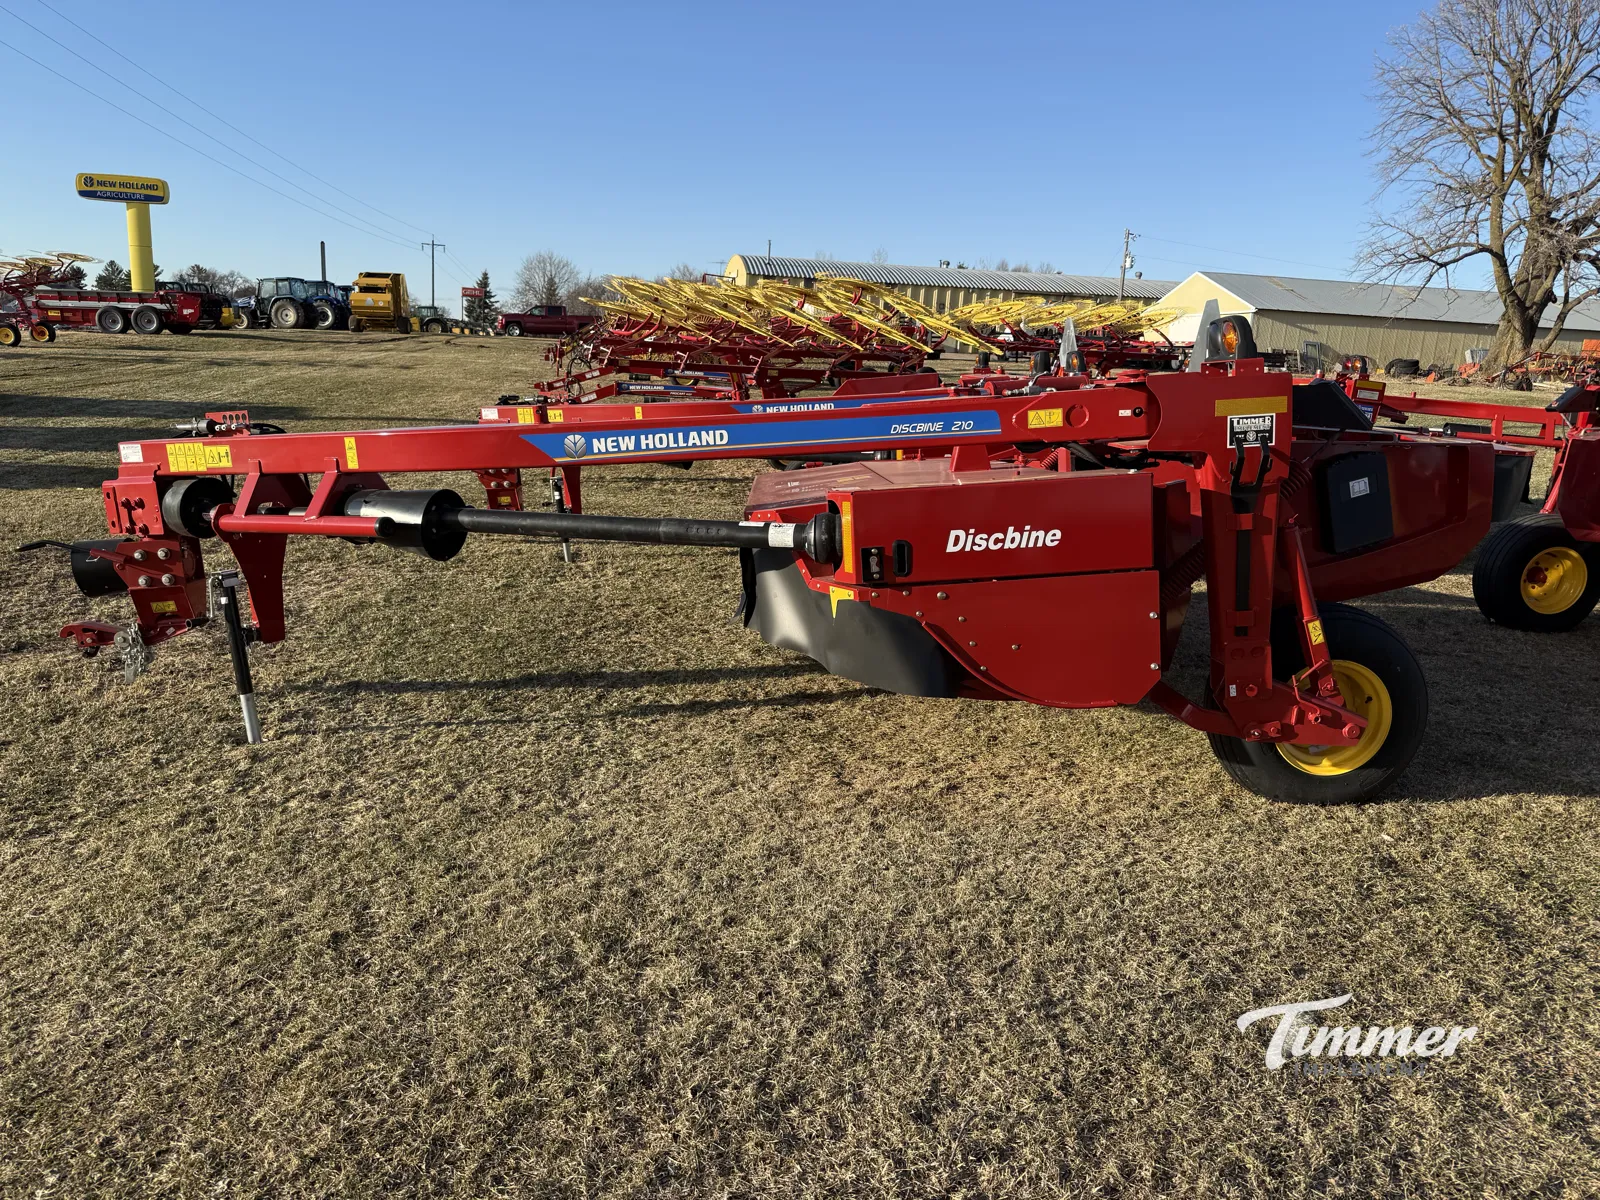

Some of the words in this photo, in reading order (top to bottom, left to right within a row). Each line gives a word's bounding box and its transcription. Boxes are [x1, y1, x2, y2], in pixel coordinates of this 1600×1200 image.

[97, 180, 116, 188] NEW
[119, 181, 159, 191] HOLLAND
[96, 191, 145, 200] AGRICULTURE
[766, 405, 788, 413] NEW
[790, 403, 835, 412] HOLLAND
[1231, 416, 1272, 426] TIMMER
[890, 421, 944, 434] DISCBINE
[951, 420, 974, 431] 210
[592, 436, 636, 453] NEW
[640, 429, 729, 450] HOLLAND
[945, 525, 1062, 553] Discbine
